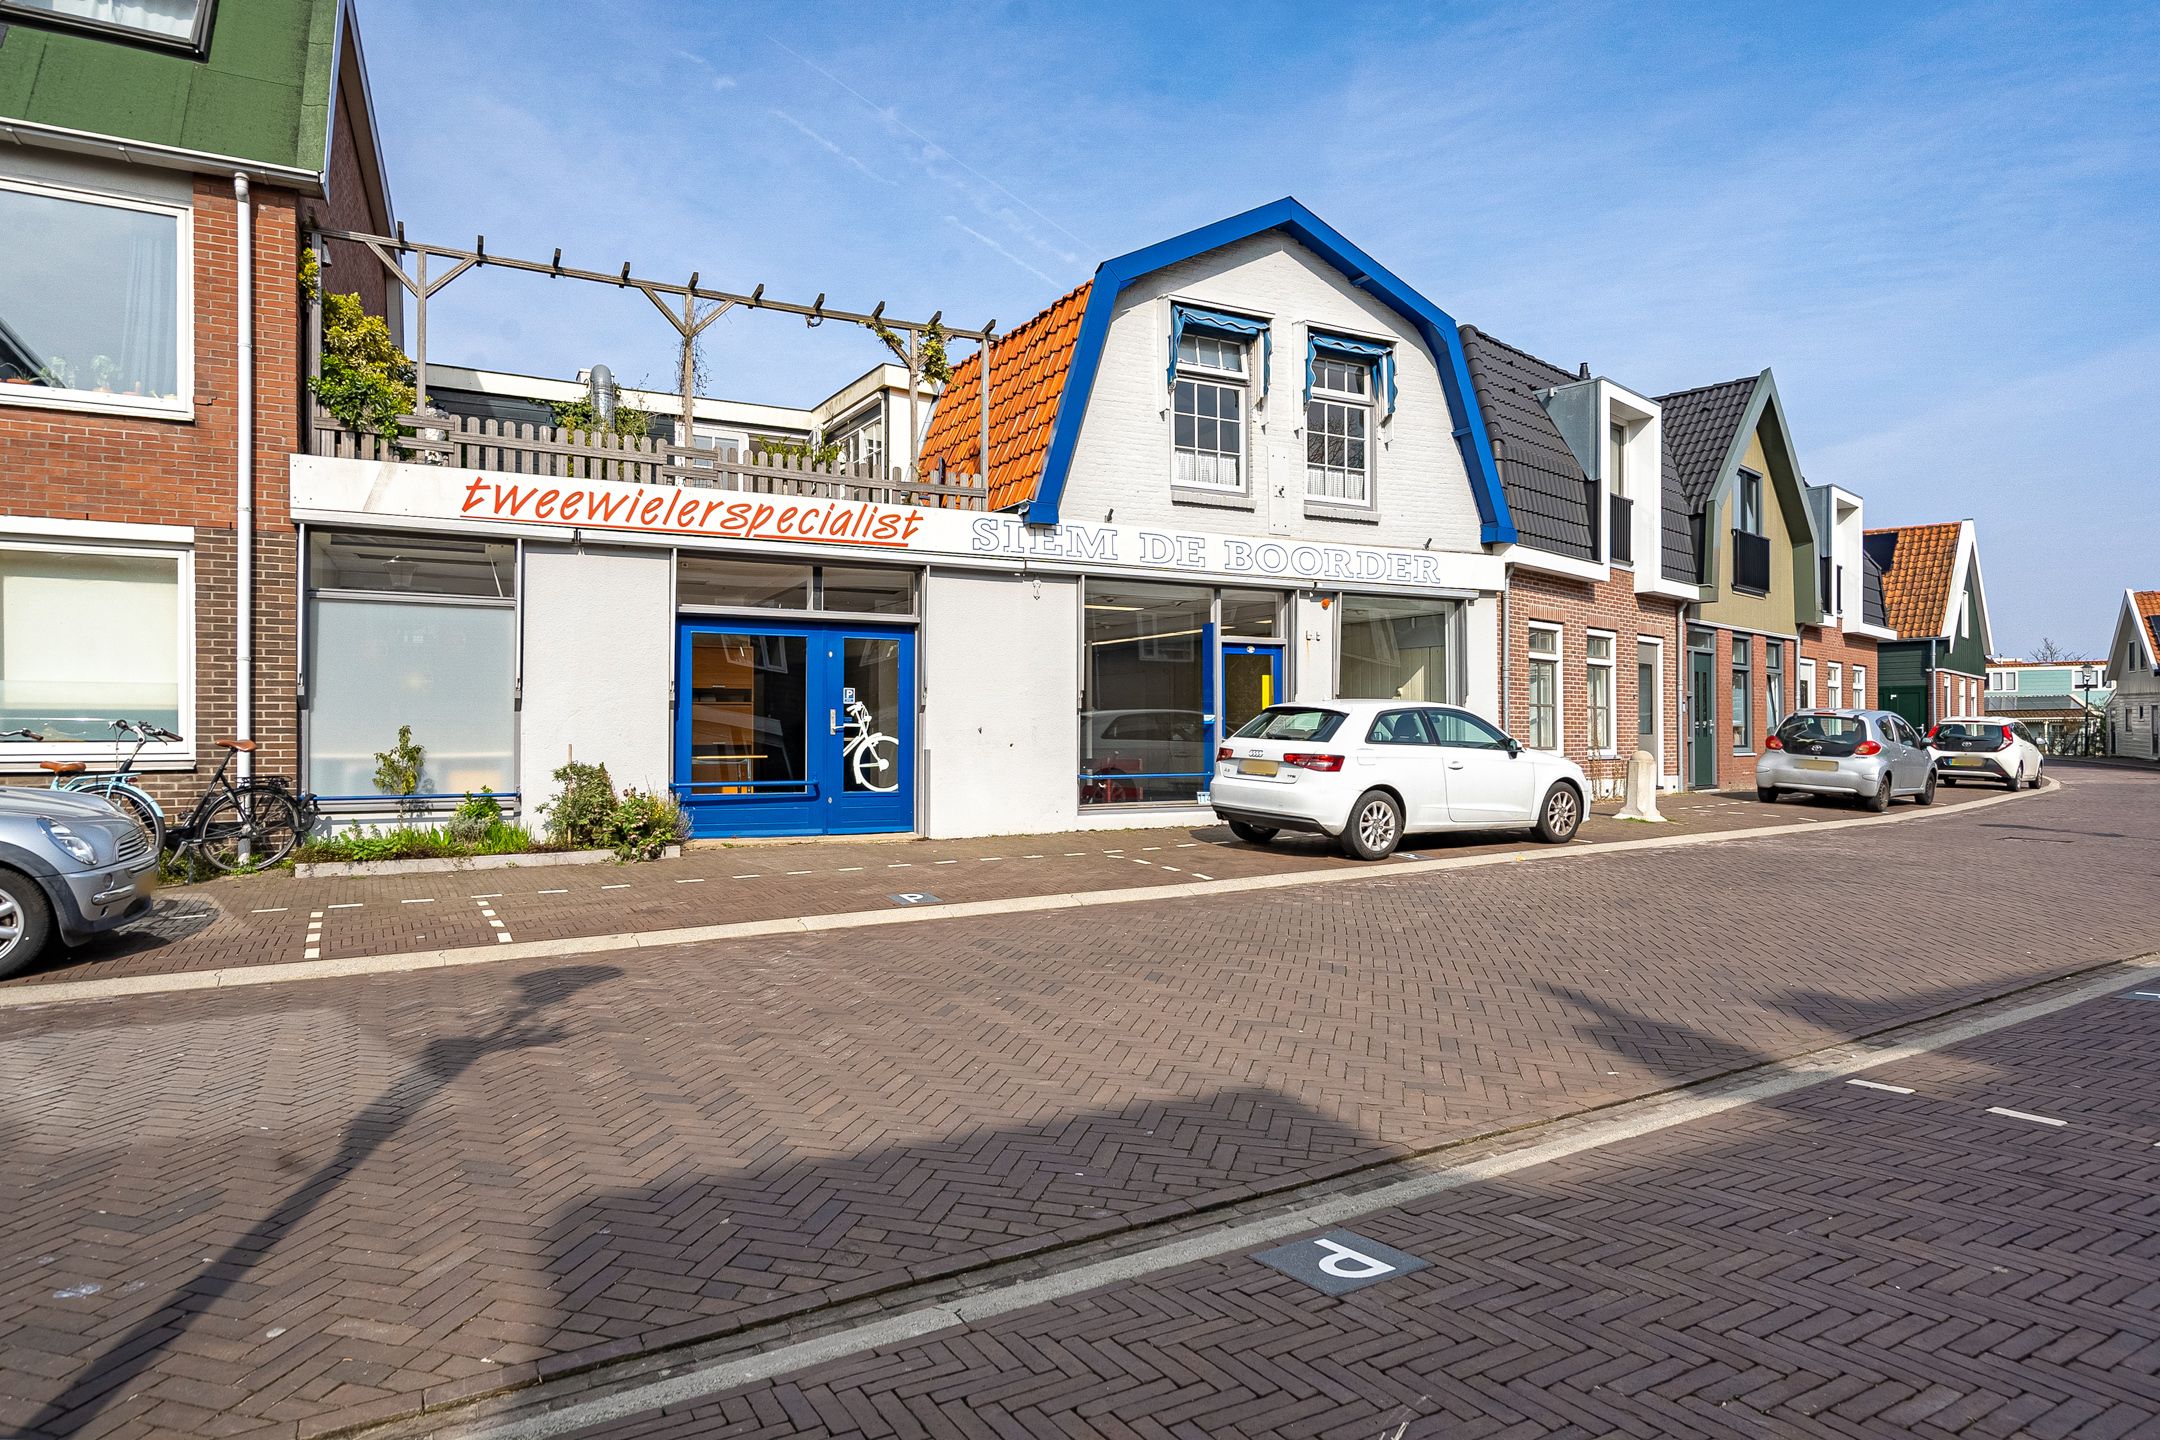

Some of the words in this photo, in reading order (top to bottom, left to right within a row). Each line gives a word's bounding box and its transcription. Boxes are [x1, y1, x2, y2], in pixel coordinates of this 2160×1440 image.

[460, 475, 924, 542] tweewielerspecialist
[972, 517, 1118, 560] SIEM
[1139, 532, 1206, 568] DE
[1223, 540, 1441, 584] BOORDER
[898, 893, 924, 903] P
[1313, 1238, 1397, 1279] P
